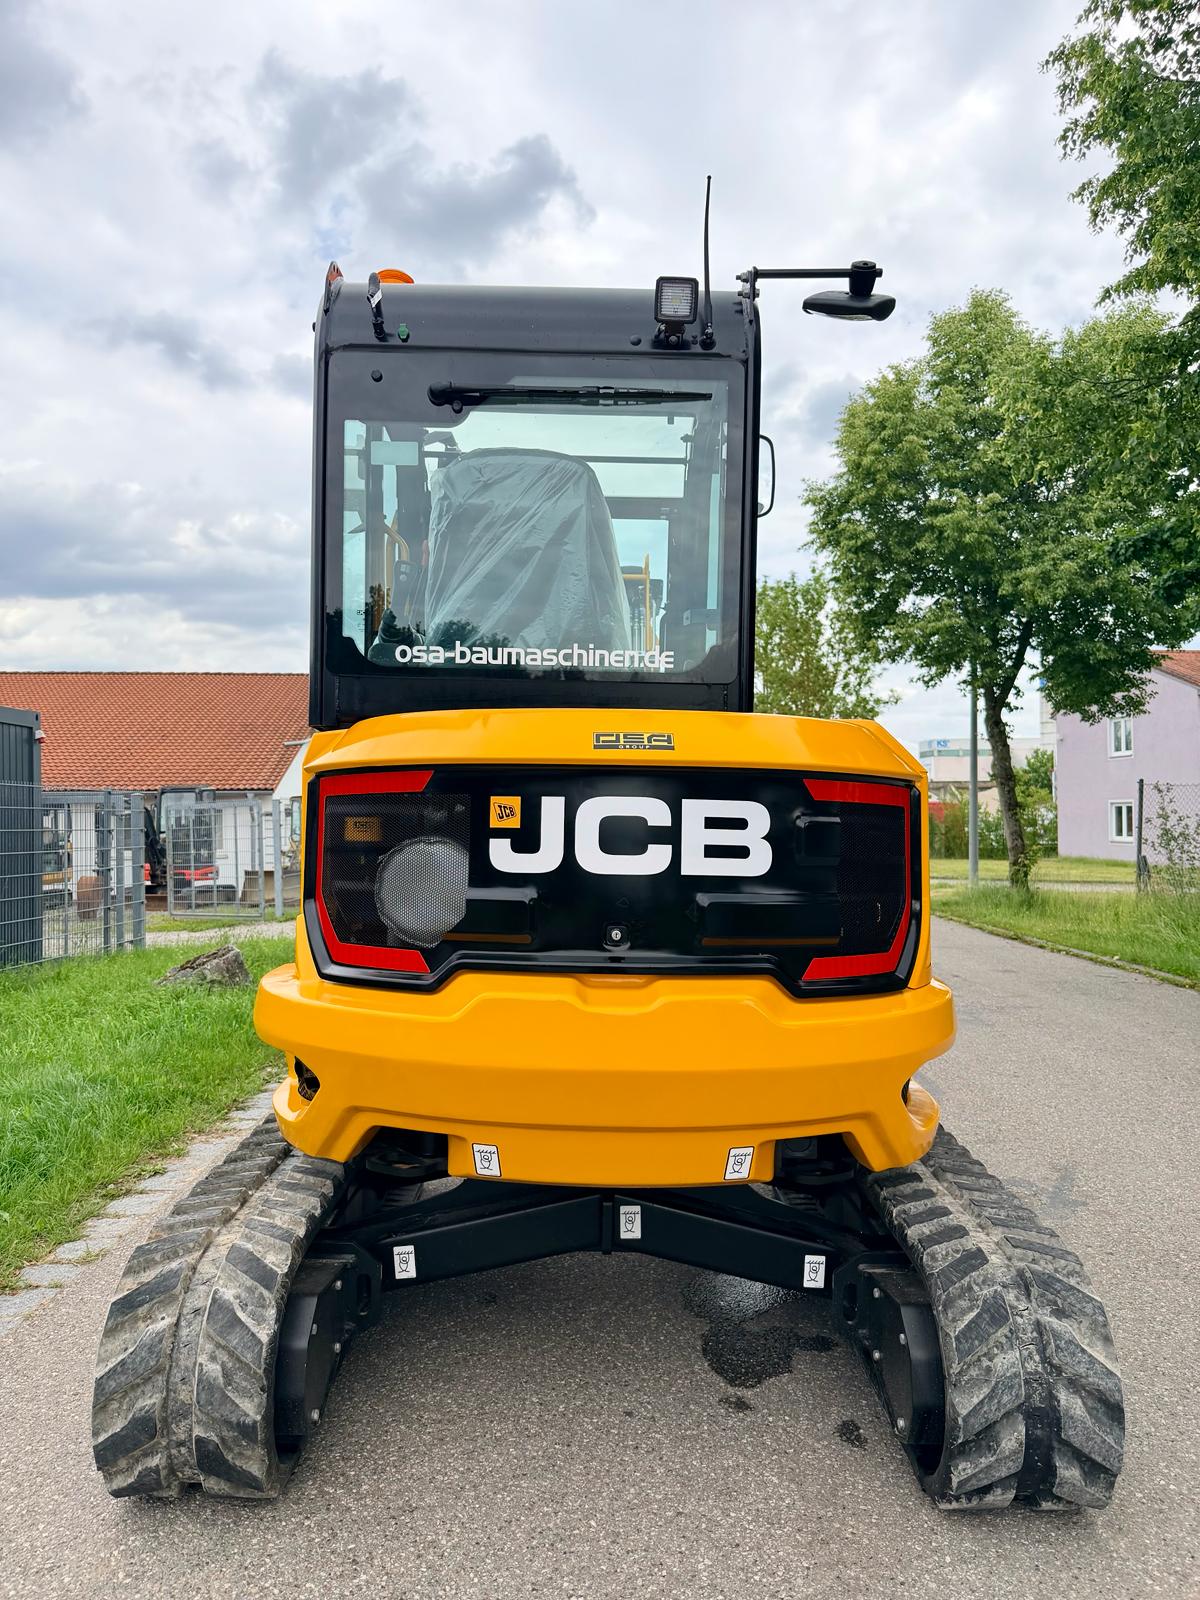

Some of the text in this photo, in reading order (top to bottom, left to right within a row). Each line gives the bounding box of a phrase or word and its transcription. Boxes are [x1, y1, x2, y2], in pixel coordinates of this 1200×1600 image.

[395, 640, 674, 669] osa-baumaschinen.de
[497, 804, 515, 820] JCB
[489, 796, 773, 877] JCB
